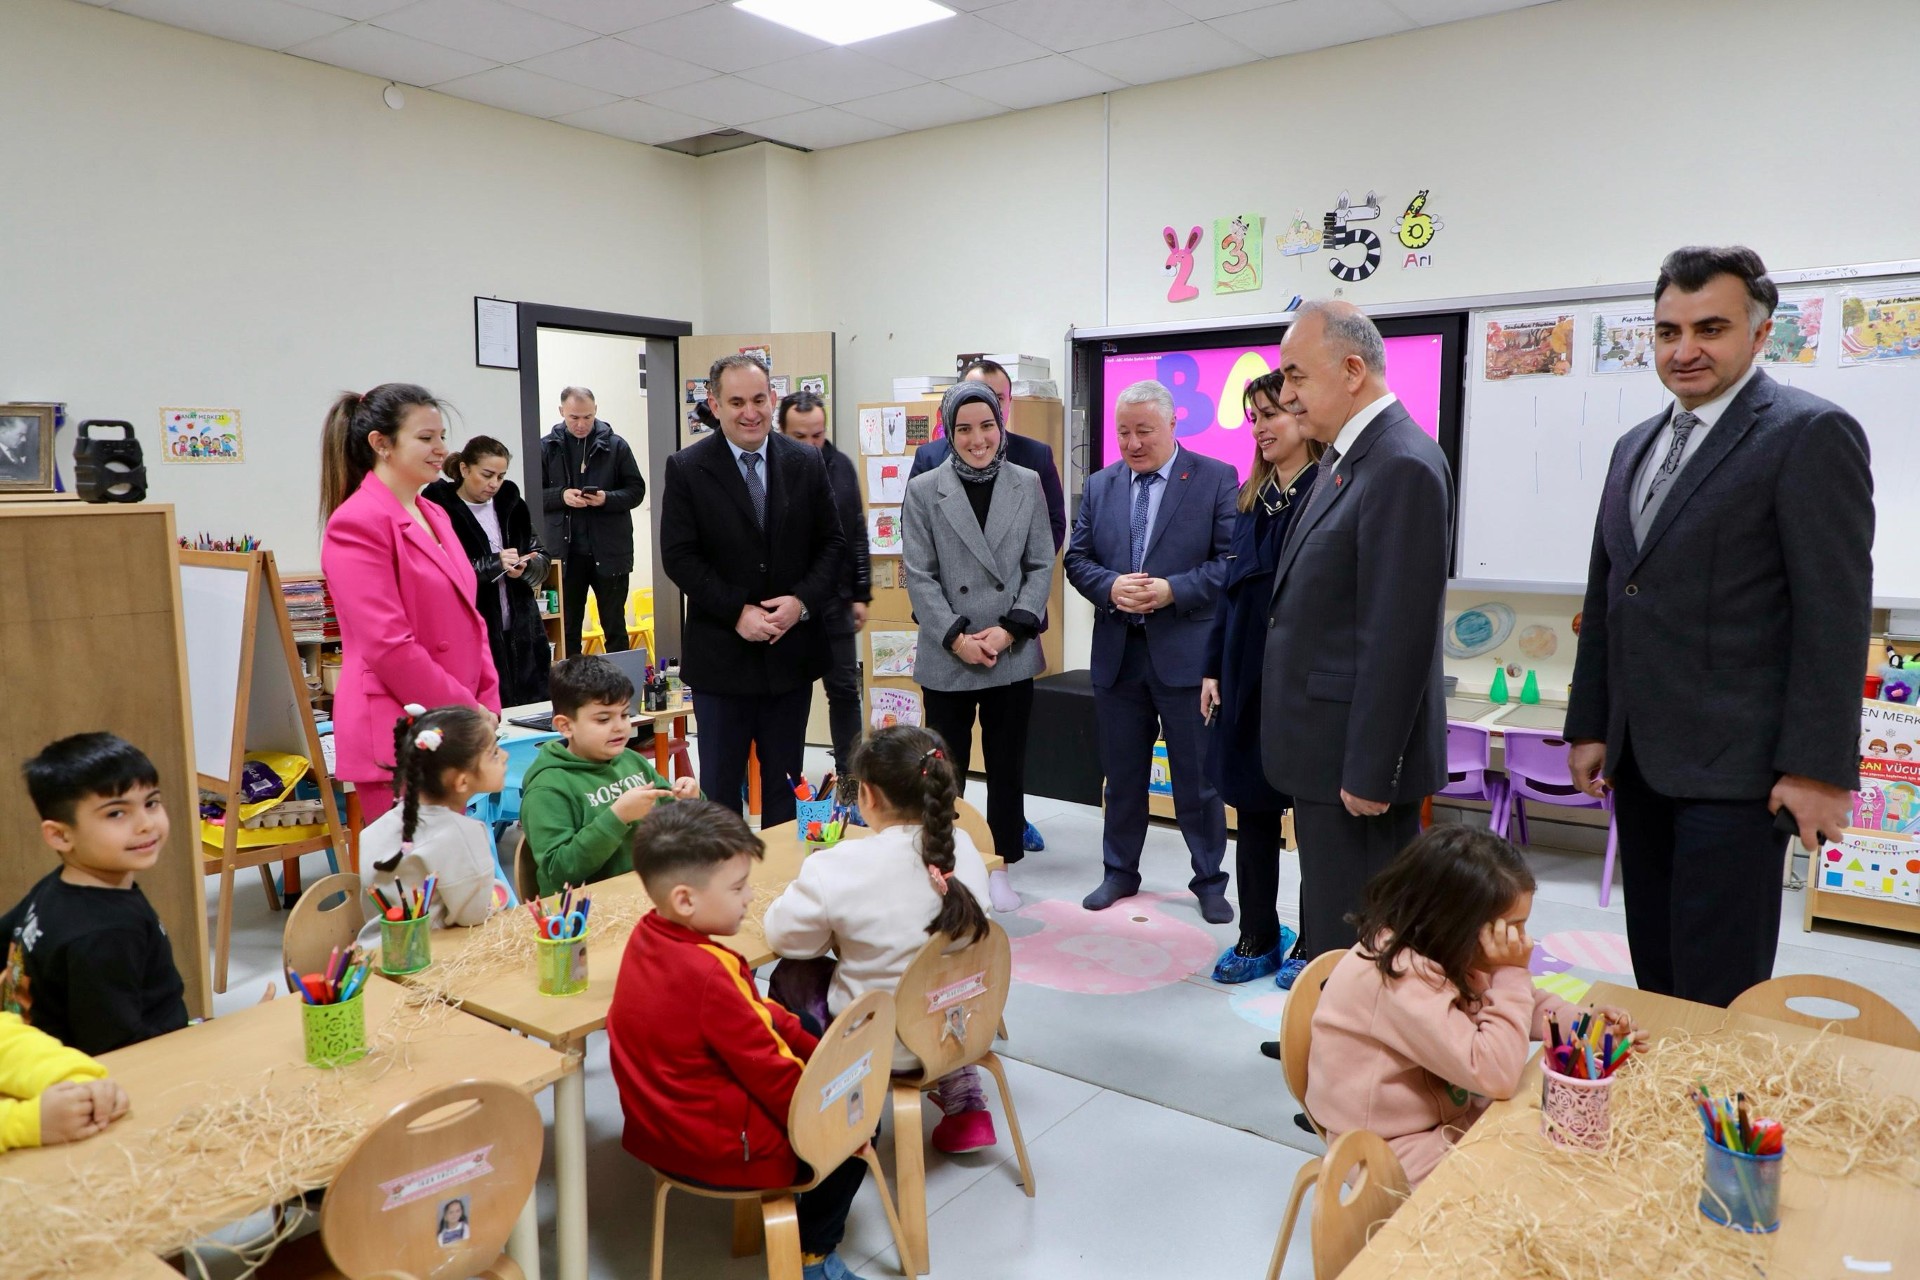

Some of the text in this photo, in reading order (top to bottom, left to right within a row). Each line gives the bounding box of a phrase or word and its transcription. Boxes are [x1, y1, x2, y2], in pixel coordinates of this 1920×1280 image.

[1222, 233, 1248, 274] 3
[1328, 203, 1381, 282] 5
[1398, 192, 1435, 249] 6
[1861, 707, 1920, 725] EN MERK
[1859, 761, 1882, 771] SAN
